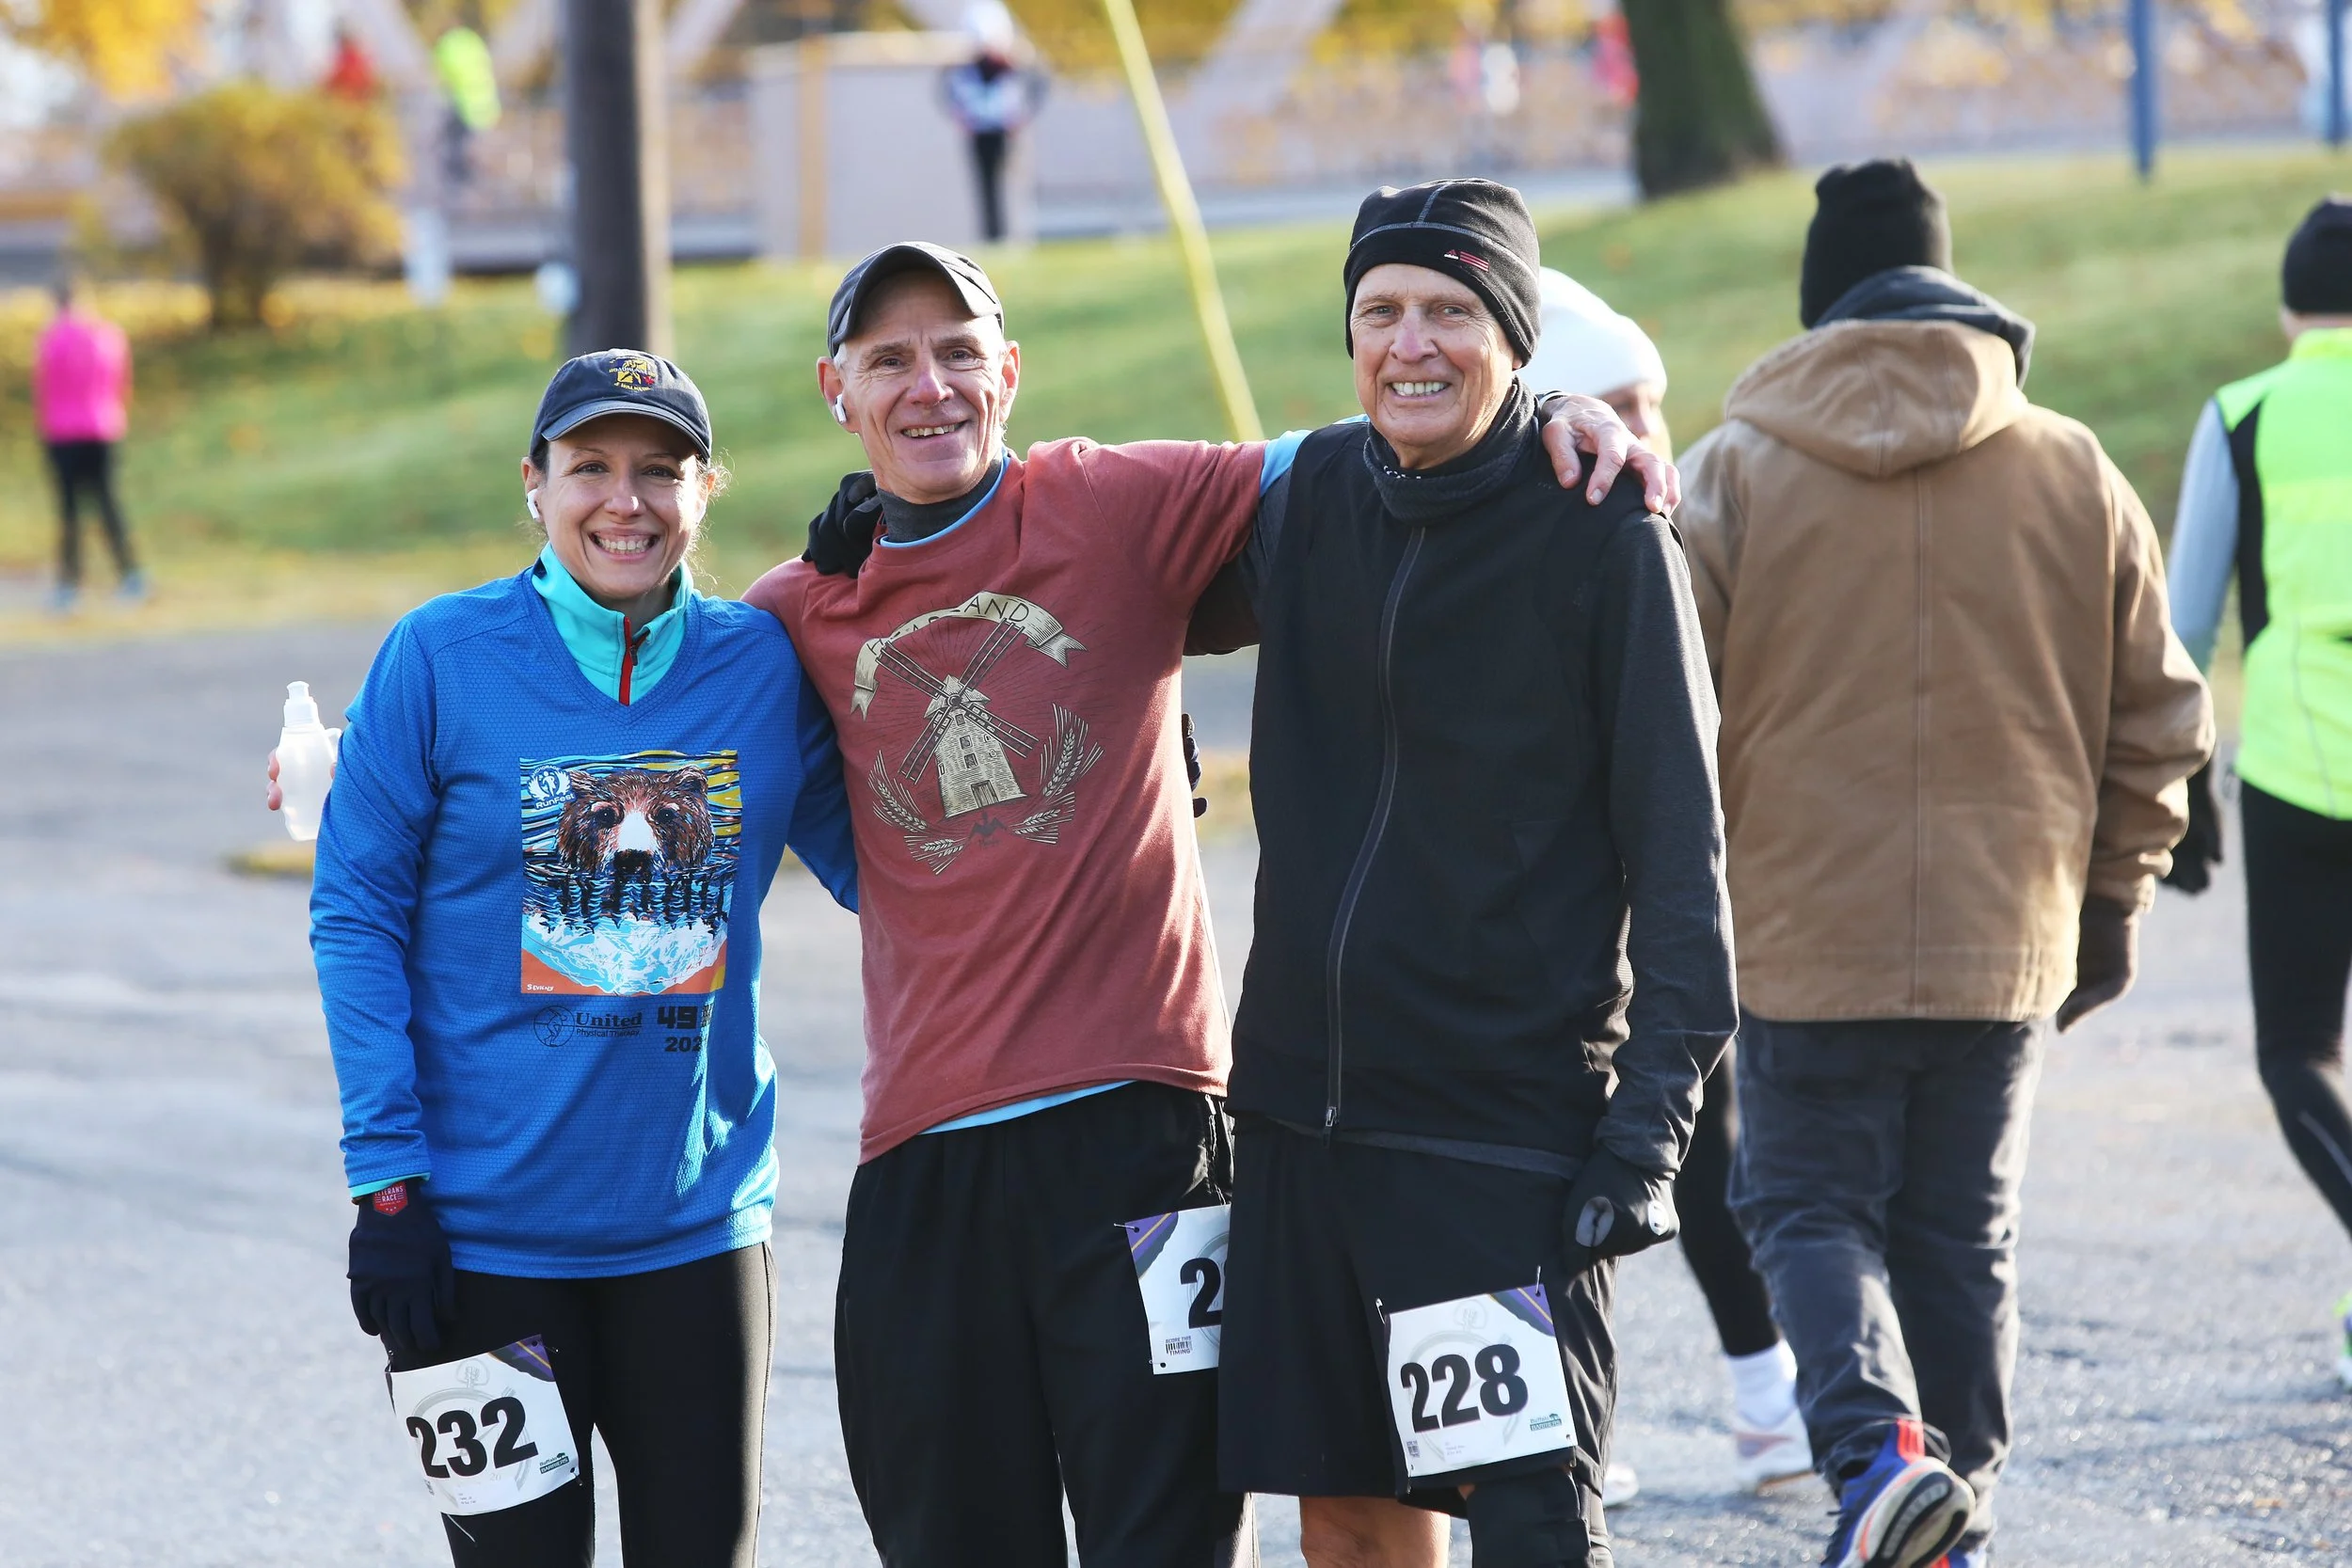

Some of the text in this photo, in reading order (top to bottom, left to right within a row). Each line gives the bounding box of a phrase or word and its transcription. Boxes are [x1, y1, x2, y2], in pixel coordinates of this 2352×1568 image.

[535, 793, 575, 809] RunFest
[576, 1011, 643, 1026] United
[381, 1195, 397, 1203] RACE
[1400, 1343, 1529, 1433] 228
[405, 1396, 539, 1479] 232
